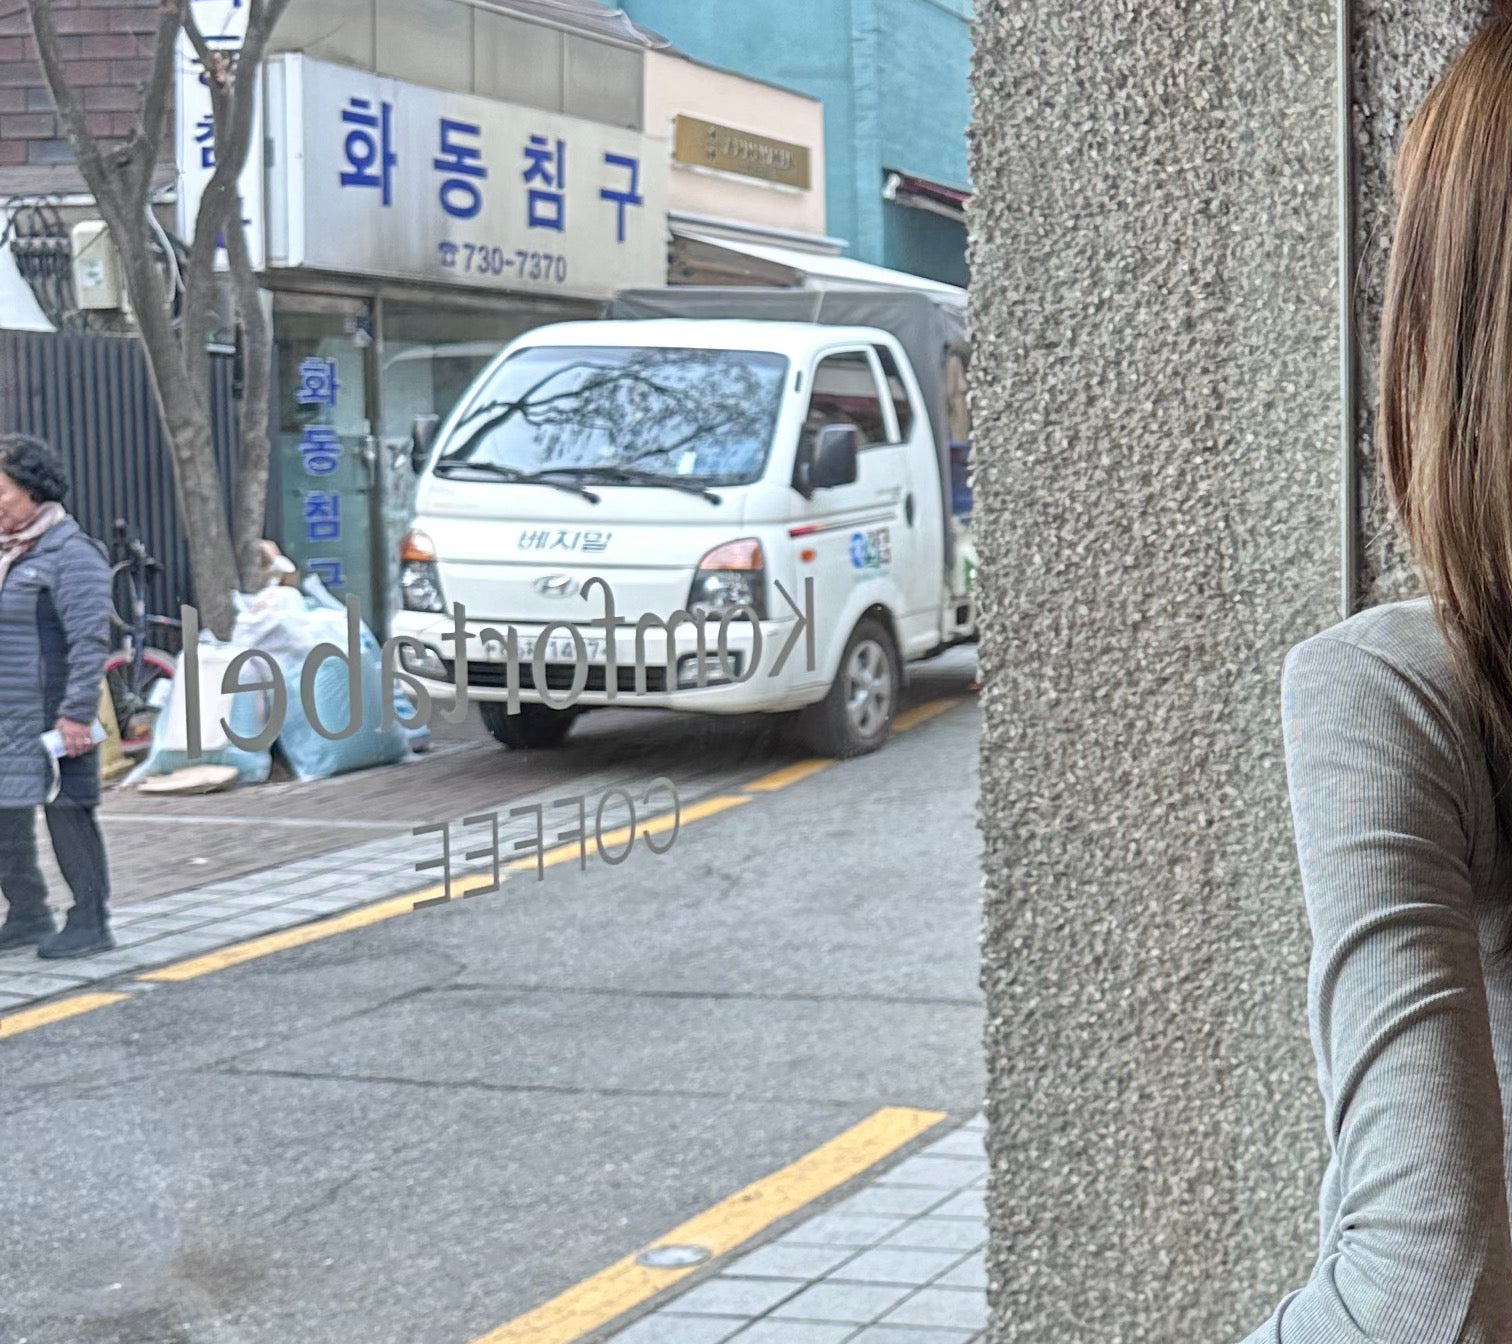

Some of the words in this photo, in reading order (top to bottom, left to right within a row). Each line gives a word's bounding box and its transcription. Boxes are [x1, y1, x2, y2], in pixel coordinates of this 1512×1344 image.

[339, 95, 644, 244] 화동침구
[462, 242, 568, 284] 730-7370
[517, 528, 613, 554] 베지밀
